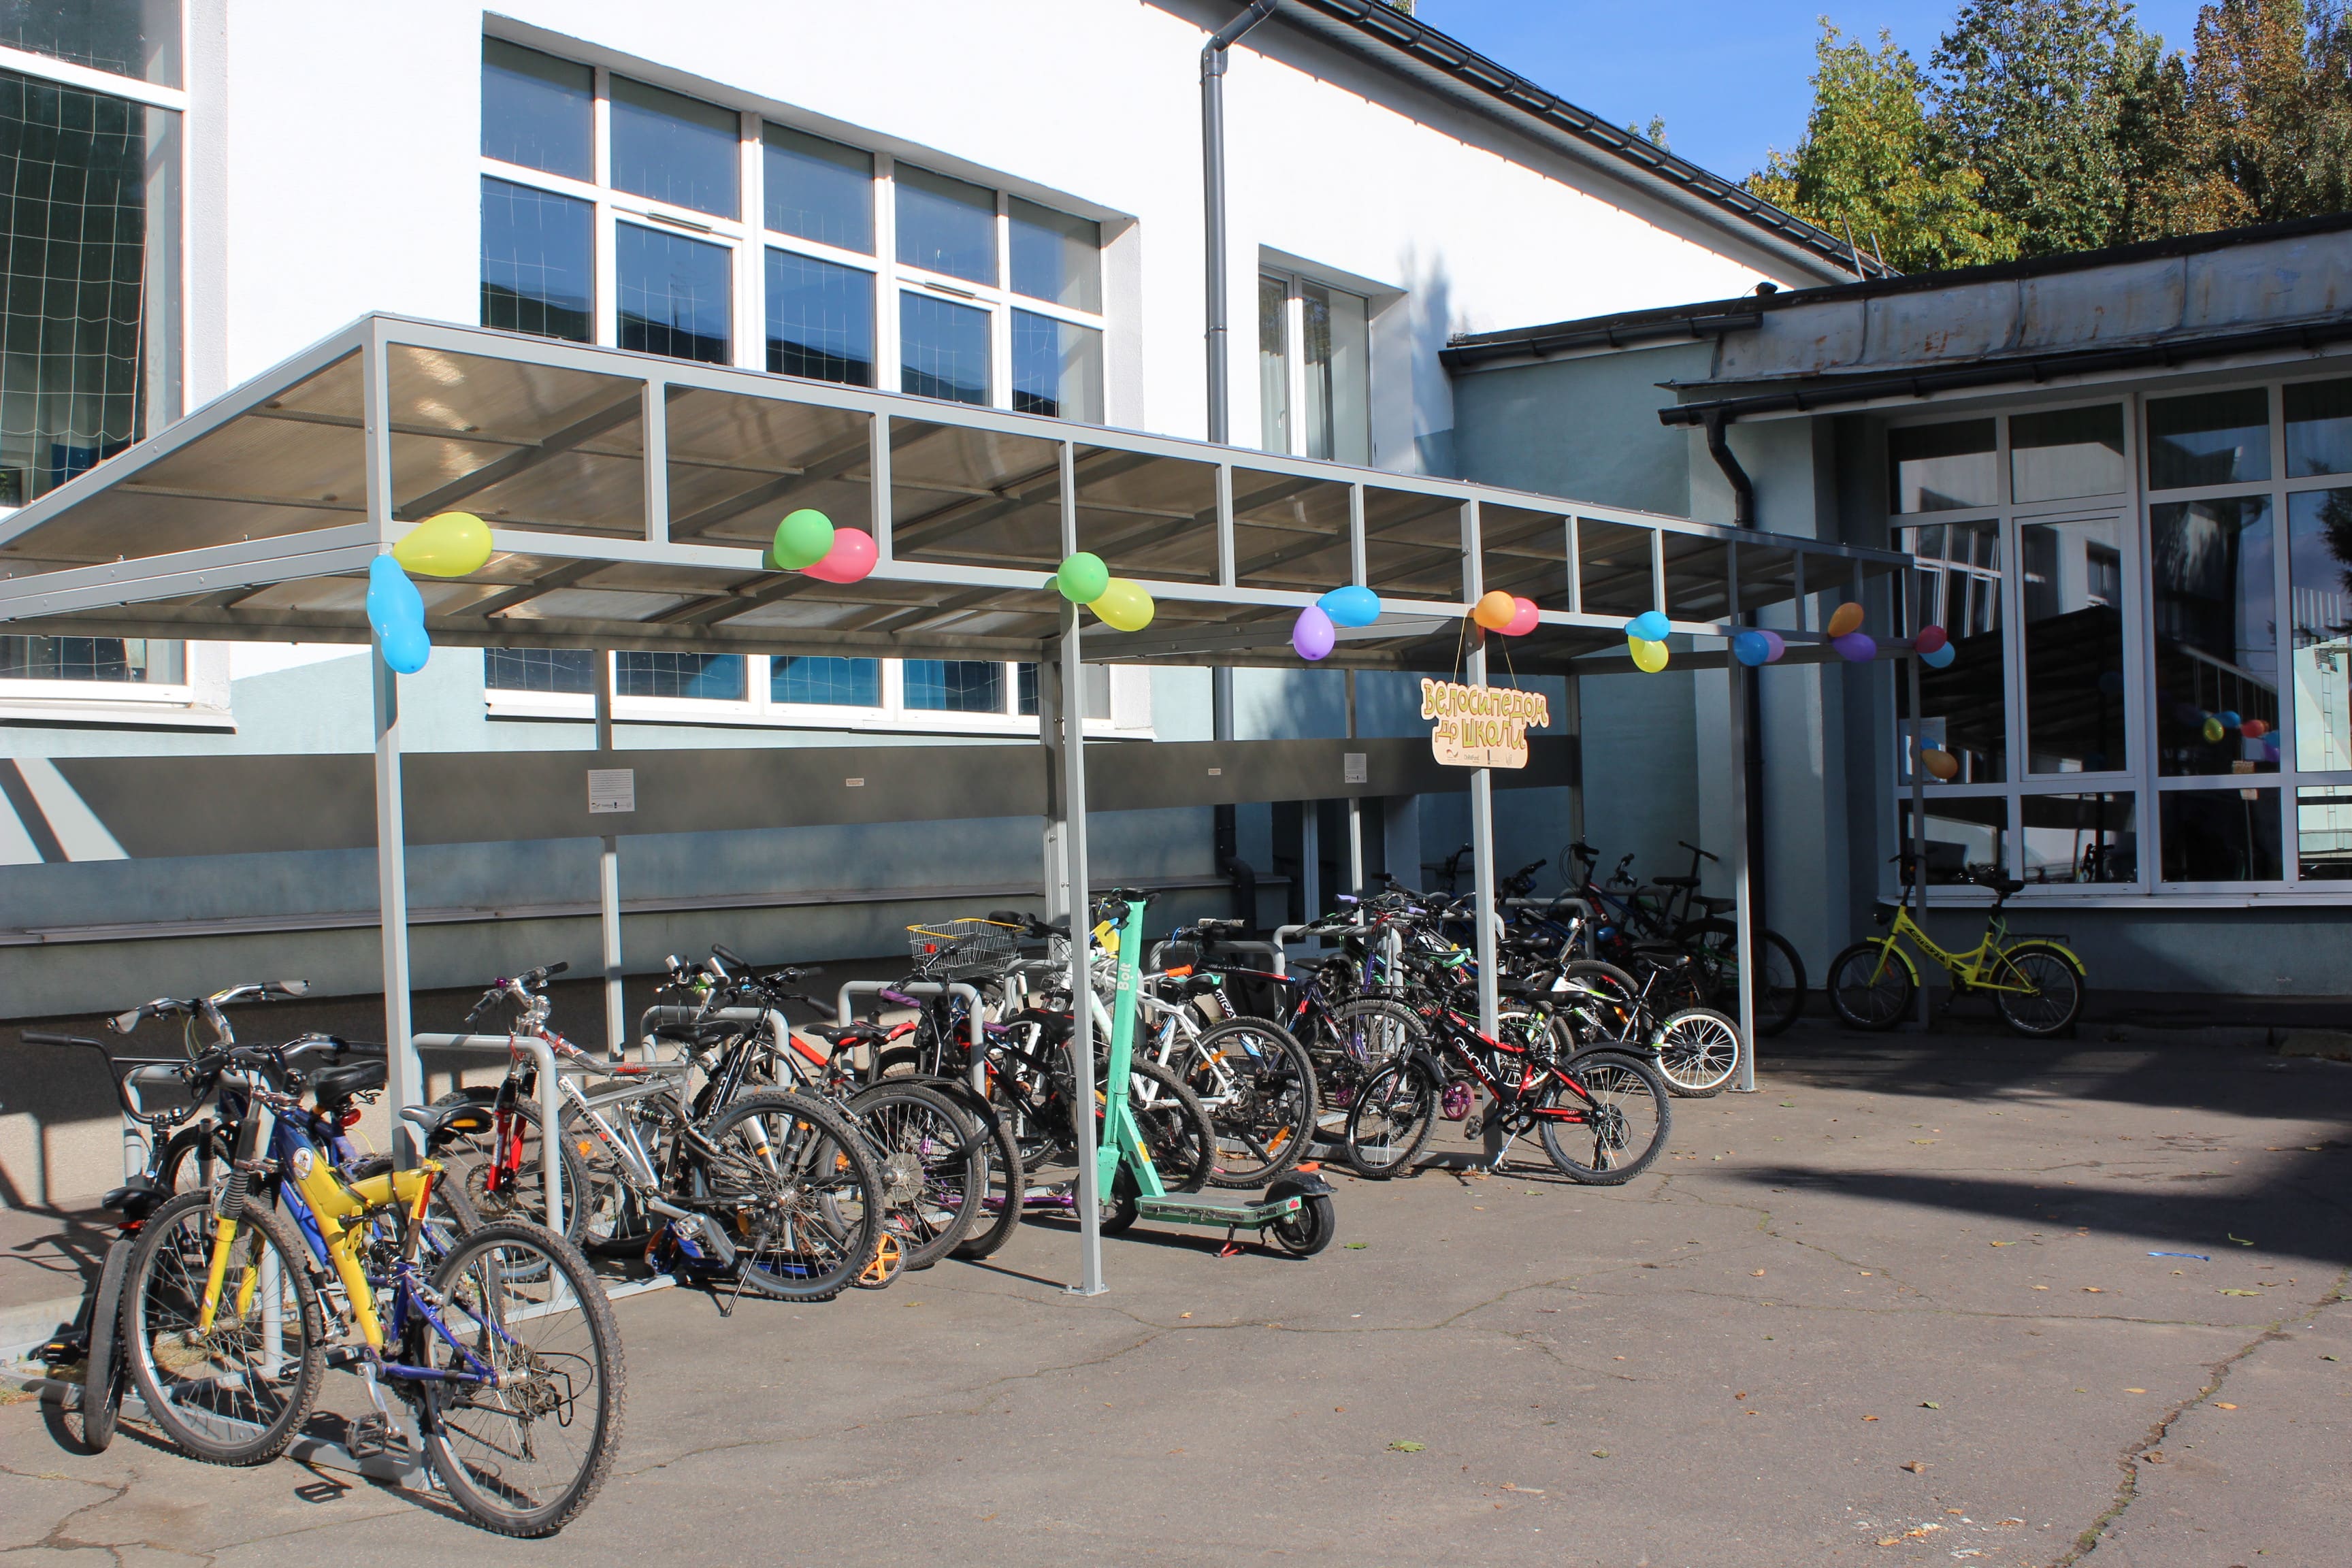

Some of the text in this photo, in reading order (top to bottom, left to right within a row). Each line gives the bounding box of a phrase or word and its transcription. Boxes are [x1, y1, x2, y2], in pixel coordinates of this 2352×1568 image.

[1424, 683, 1548, 725] Велосипедом
[1435, 719, 1458, 744] до
[1117, 962, 1132, 991] Bolt
[1454, 1036, 1496, 1081] GHOST
